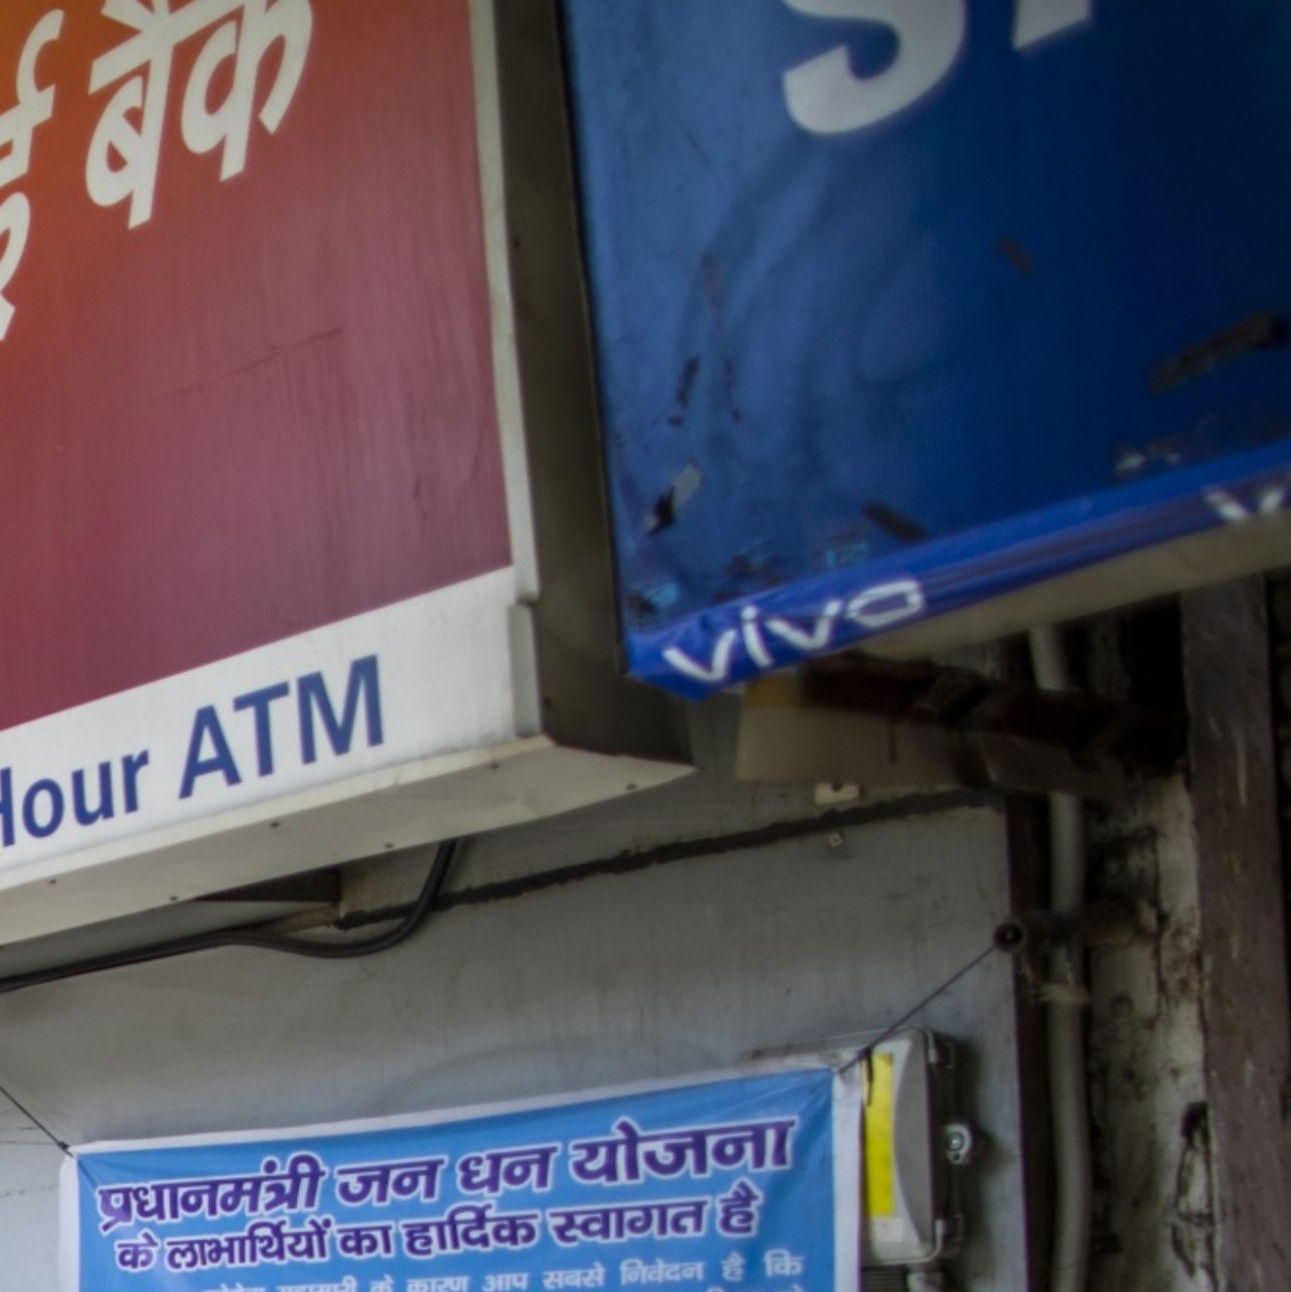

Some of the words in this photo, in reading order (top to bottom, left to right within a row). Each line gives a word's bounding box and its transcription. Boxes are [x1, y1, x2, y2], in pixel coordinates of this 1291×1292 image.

[664, 579, 923, 681] vivo
[178, 653, 385, 799] ATM
[97, 1153, 325, 1232] प्रधानमंत्री
[336, 1158, 446, 1204] जन
[458, 1146, 558, 1193] धन
[571, 1119, 796, 1182] योजना
[117, 1232, 158, 1269] के
[167, 1217, 332, 1270] लाभार्थियों
[336, 1225, 393, 1257] का
[402, 1204, 539, 1256] हार्दिक
[549, 1200, 707, 1244] स्वागत
[718, 1180, 759, 1235] है
[482, 1272, 528, 1292] आप
[542, 1262, 605, 1290] सबसे
[620, 1258, 704, 1285] निवेदन
[721, 1252, 745, 1281] है
[764, 1249, 804, 1277] कि
